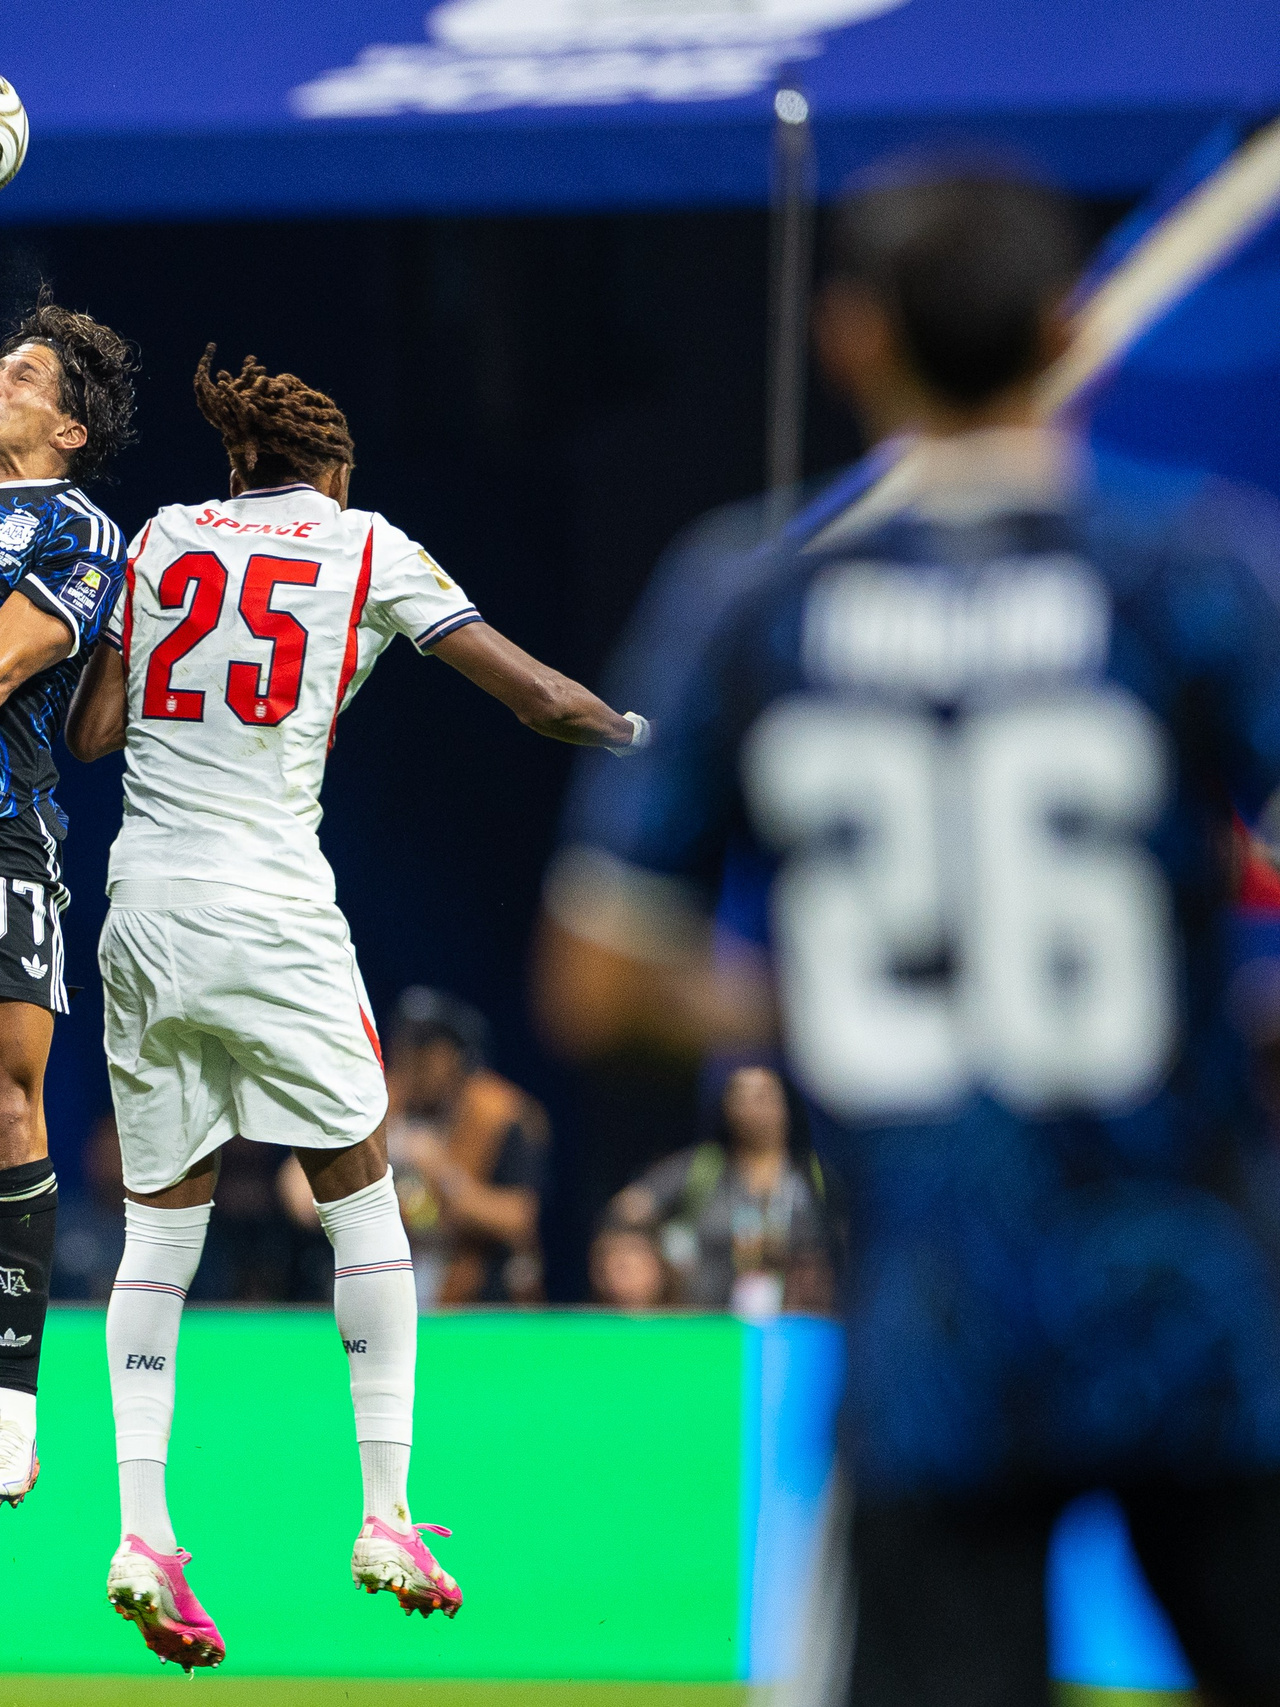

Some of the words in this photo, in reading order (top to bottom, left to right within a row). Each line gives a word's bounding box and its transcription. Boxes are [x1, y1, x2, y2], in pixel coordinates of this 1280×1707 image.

[195, 508, 322, 538] SPENCE
[141, 550, 322, 727] 25
[744, 695, 1180, 1115] 26
[125, 1353, 166, 1371] ENG
